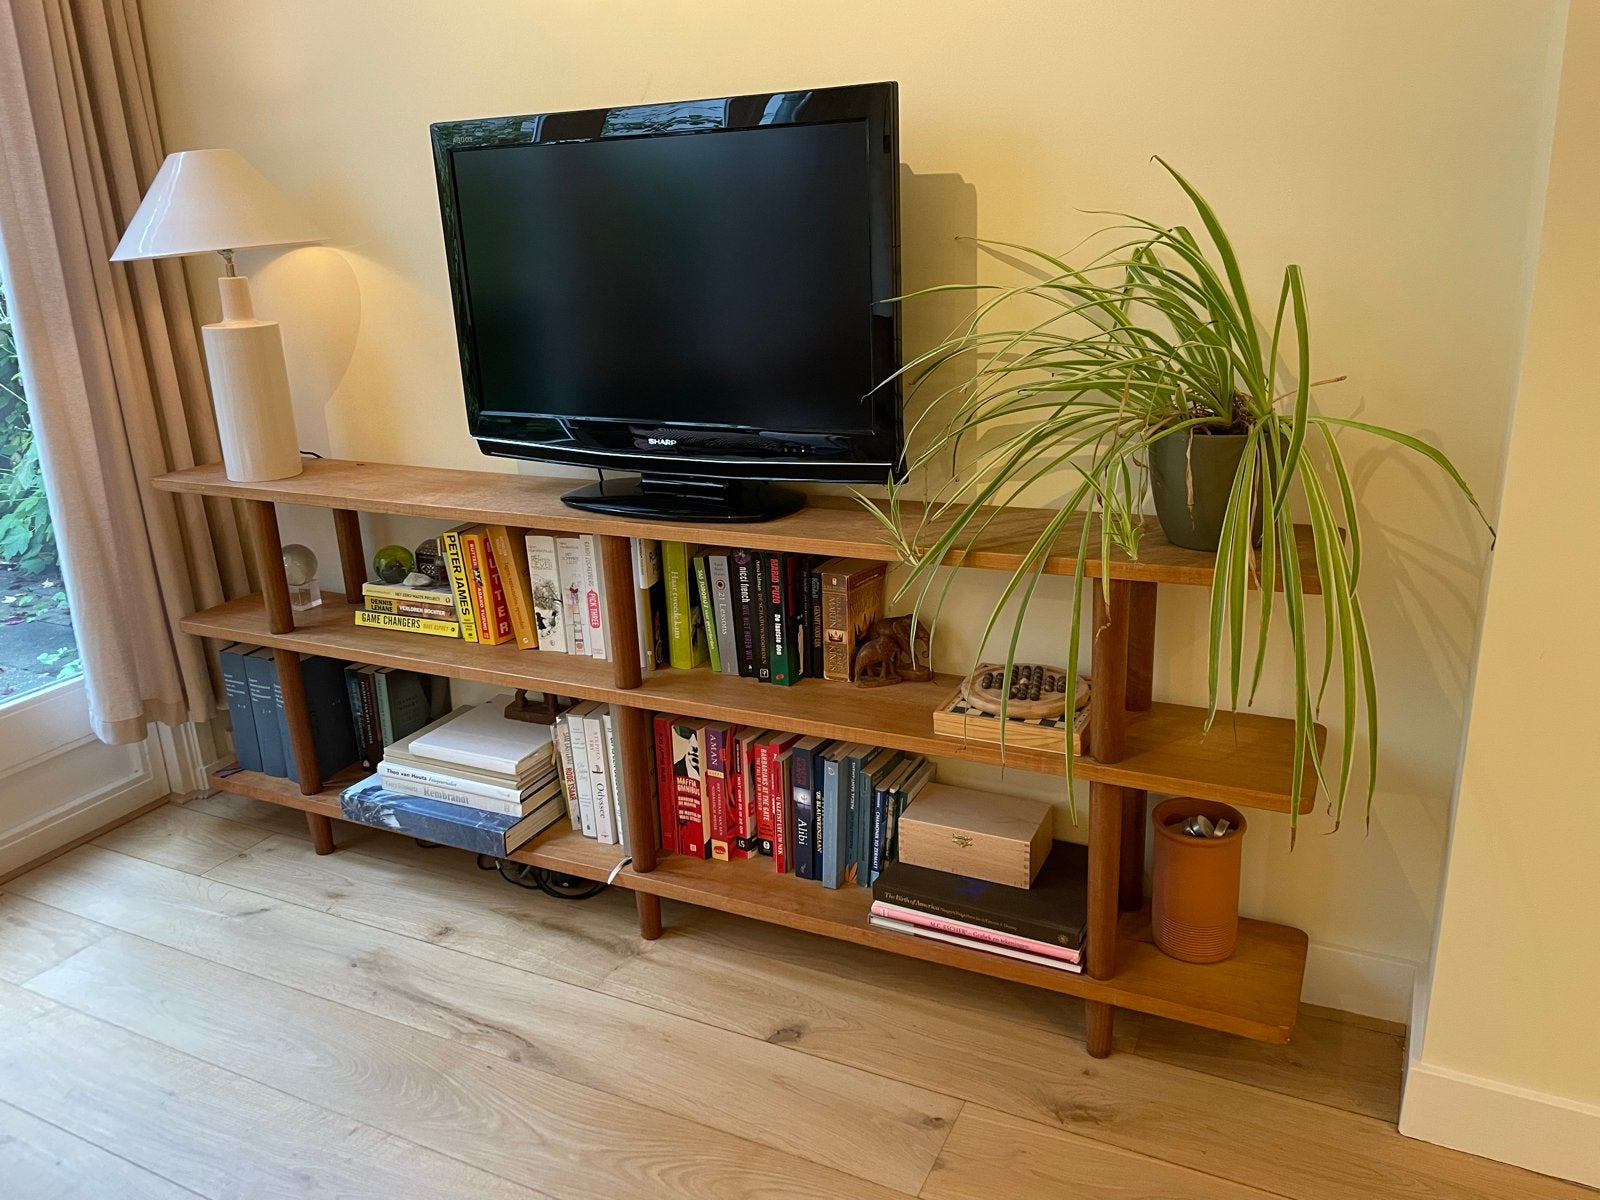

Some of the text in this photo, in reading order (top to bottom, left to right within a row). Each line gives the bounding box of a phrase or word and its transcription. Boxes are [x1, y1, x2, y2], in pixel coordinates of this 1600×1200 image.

[648, 438, 677, 446] SHARP
[447, 535, 462, 574] PETER
[455, 574, 470, 616] JAMES
[739, 566, 748, 582] nicci
[770, 558, 780, 583] MARIO
[469, 543, 488, 631] BUTTER ASAKO YUZUKI
[741, 583, 751, 603] french
[771, 585, 781, 604] PUZO
[371, 598, 393, 607] DENNIS
[371, 604, 393, 613] LEHANE
[588, 593, 600, 627] PICK THREE
[361, 613, 381, 624] GAME
[383, 615, 421, 629] CHANGERS
[719, 592, 728, 635] 21 Lessons
[774, 613, 781, 622] De
[775, 643, 783, 656] don
[709, 734, 719, 766] AMAN
[387, 768, 400, 776] Theo
[565, 767, 575, 784] RODE
[761, 748, 769, 786] BARBARIANS
[677, 777, 697, 787] MAFFIA
[762, 786, 769, 794] AT
[424, 786, 470, 805] Rembrandt
[596, 783, 606, 819] Odyssee
[762, 806, 770, 821] GATE
[798, 818, 808, 846] Alibi
[872, 846, 880, 869] ZERMATT
[885, 891, 895, 900] The
[896, 894, 909, 904] Birth
[909, 898, 917, 906] of
